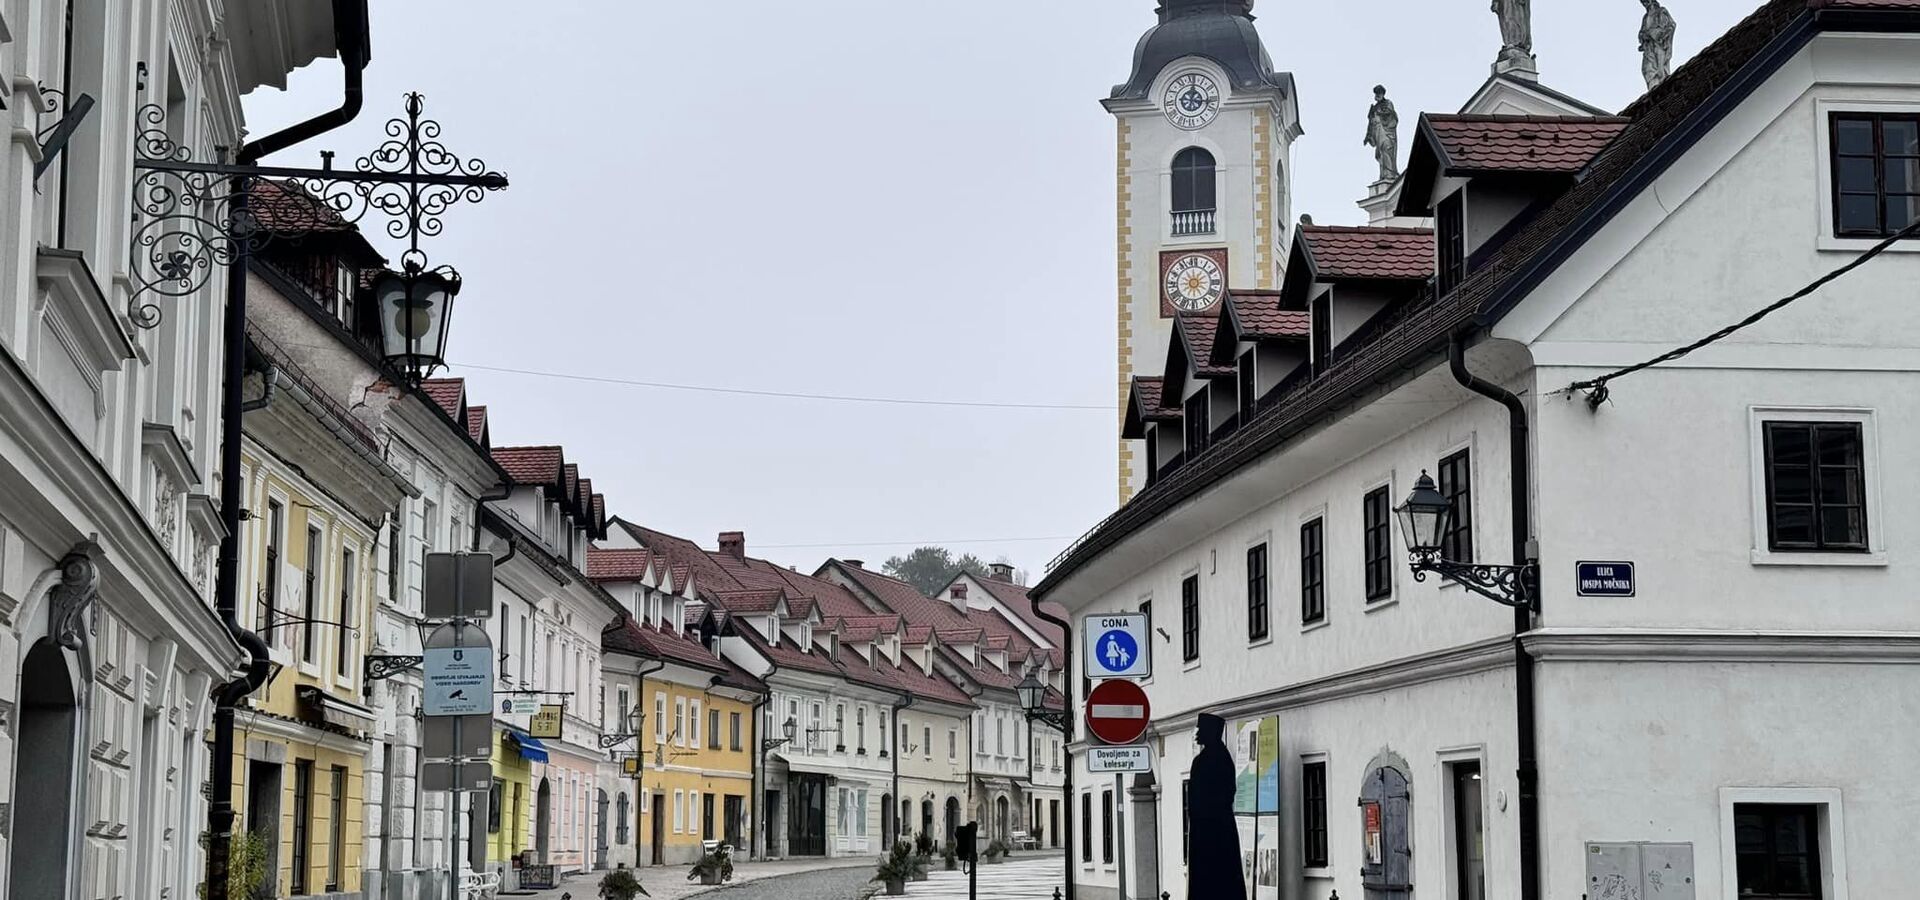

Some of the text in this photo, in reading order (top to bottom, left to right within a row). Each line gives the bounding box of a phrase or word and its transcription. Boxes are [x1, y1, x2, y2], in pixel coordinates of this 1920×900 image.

[1597, 567, 1614, 576] ULICA
[1101, 618, 1129, 628] CONA
[1096, 749, 1141, 760] Dovoljeno za
[1103, 760, 1135, 770] kolesarje
